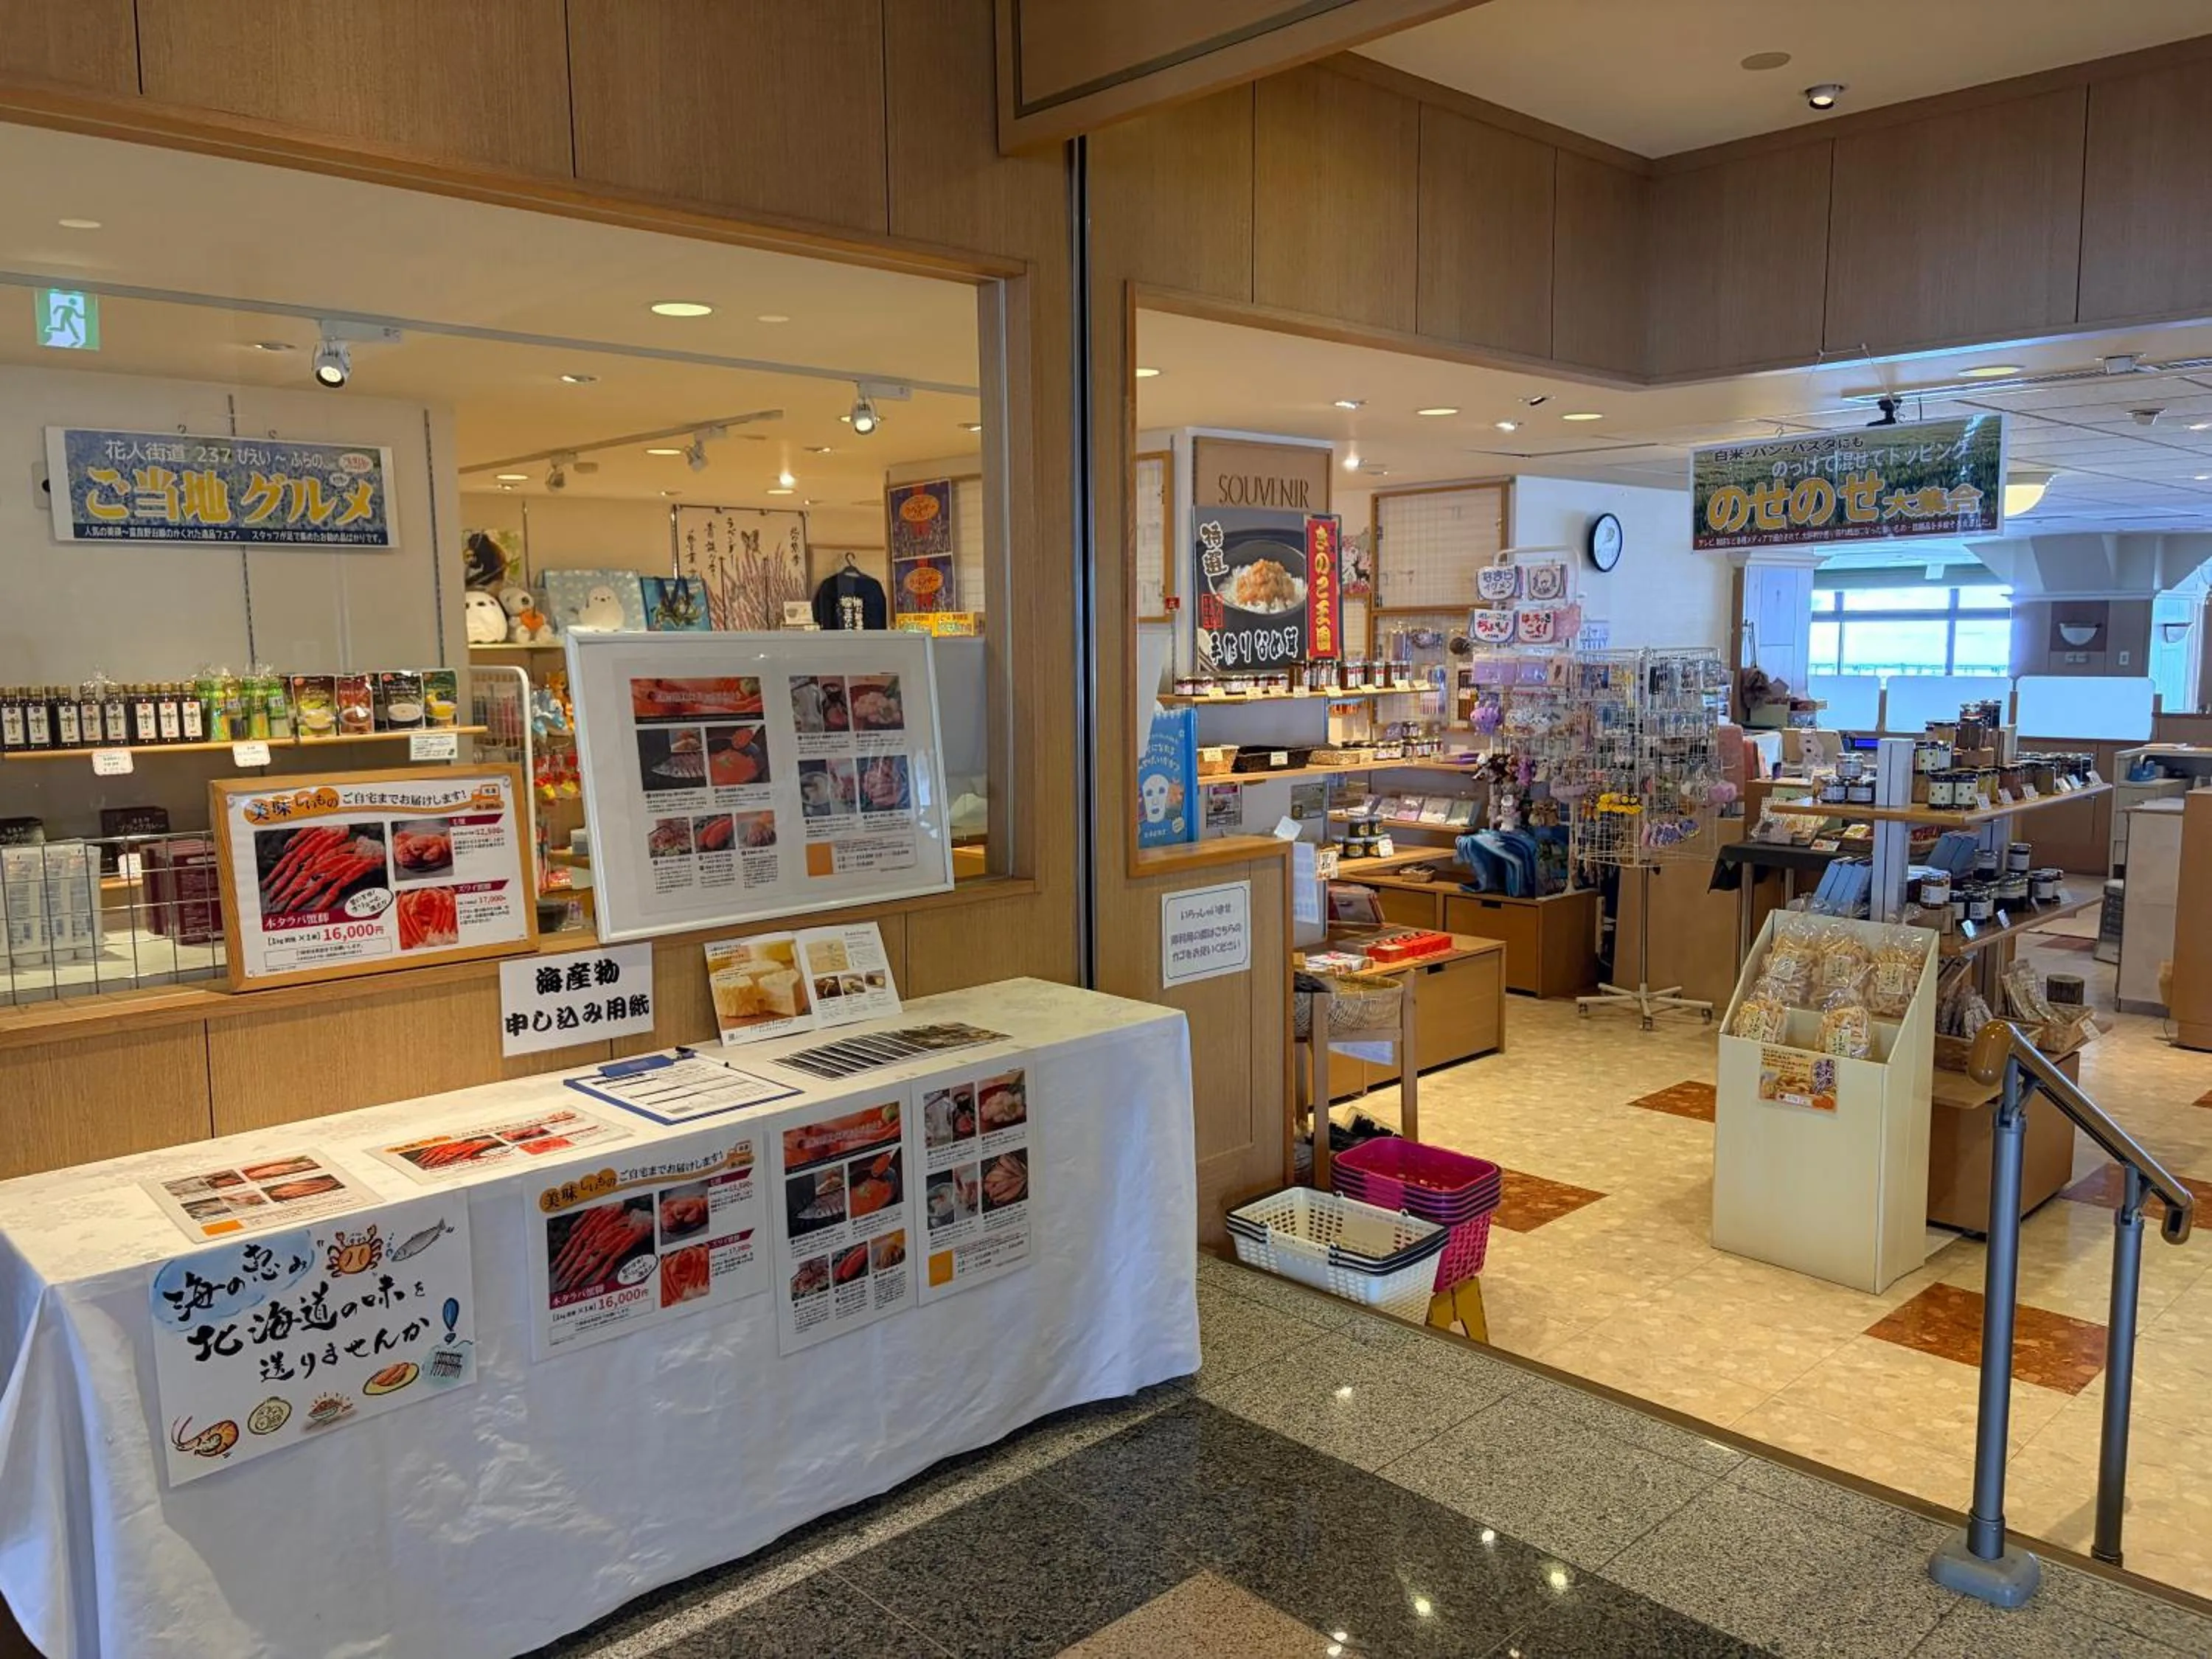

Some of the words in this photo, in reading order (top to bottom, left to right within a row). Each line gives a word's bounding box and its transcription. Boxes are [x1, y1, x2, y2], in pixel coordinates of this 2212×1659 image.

[105, 439, 186, 462] 花人街道
[196, 446, 232, 463] 237
[1218, 474, 1310, 508] SOUVENIR
[535, 959, 621, 995] 海産物
[504, 992, 651, 1037] 申し込み用紙
[162, 1244, 307, 1322] 海の恵み
[187, 1273, 425, 1362] 北海道の味を
